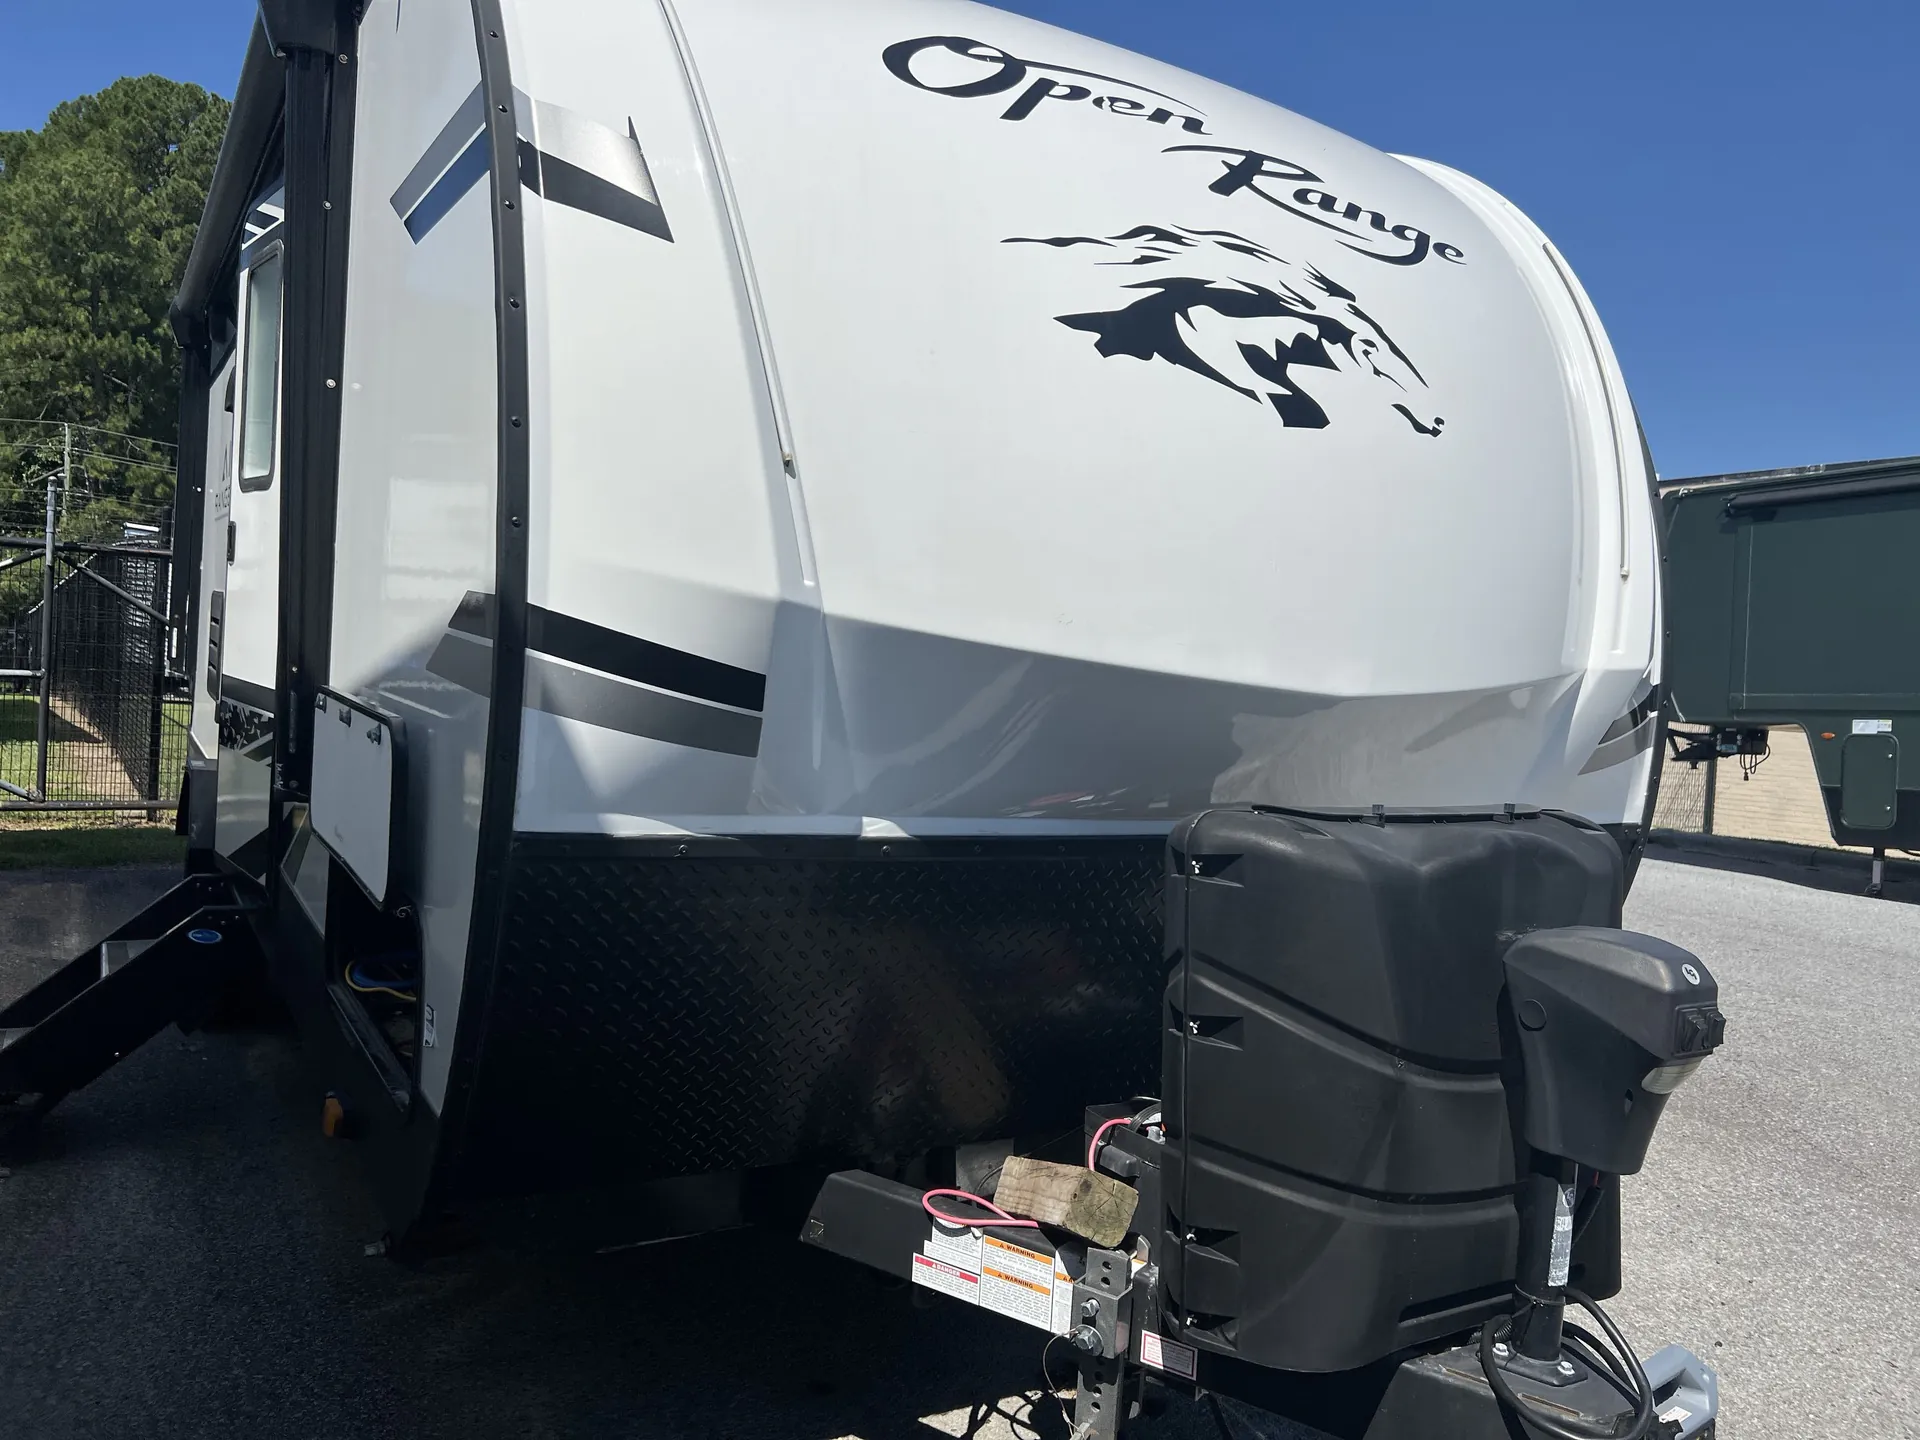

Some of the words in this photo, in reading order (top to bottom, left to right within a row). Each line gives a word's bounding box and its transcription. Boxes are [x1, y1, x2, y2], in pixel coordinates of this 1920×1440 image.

[882, 36, 1213, 136] Open
[1161, 144, 1467, 266] Range
[1006, 1244, 1035, 1259] WARNING
[936, 1264, 961, 1278] DANGER
[1004, 1274, 1033, 1289] WARNING
